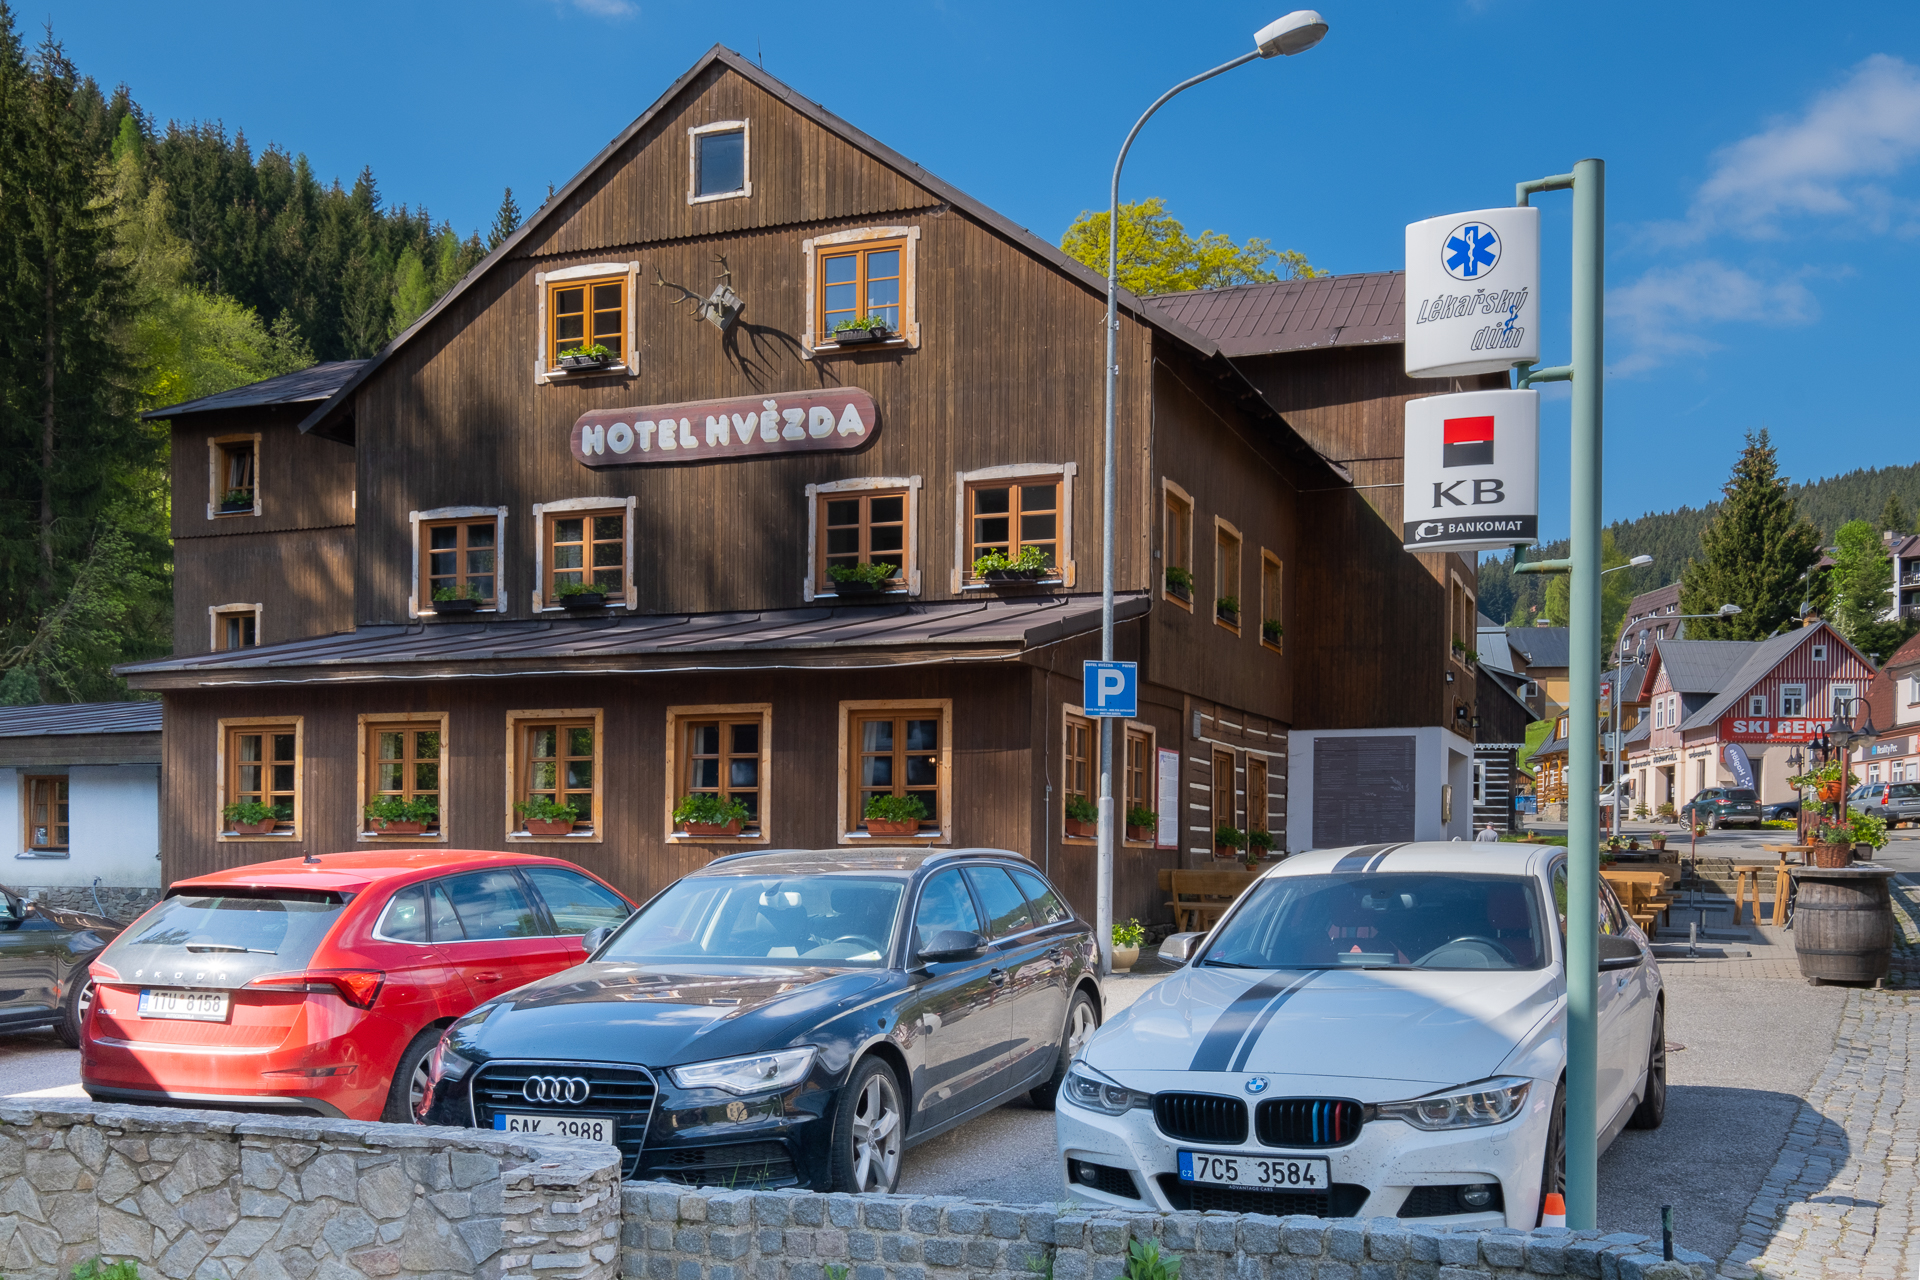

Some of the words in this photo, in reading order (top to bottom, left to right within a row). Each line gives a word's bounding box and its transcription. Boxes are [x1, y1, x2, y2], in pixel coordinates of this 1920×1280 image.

[1416, 286, 1528, 328] Lékařský
[1471, 321, 1525, 351] dům
[581, 417, 699, 456] HOTEL
[705, 400, 866, 447] HVĚZDA
[1432, 478, 1506, 508] KB
[1448, 520, 1523, 534] BANKOMAT
[1098, 669, 1125, 707] P
[1733, 720, 1769, 733] SKI
[1777, 721, 1833, 734] RENT
[1876, 744, 1890, 755] Reality
[1890, 743, 1898, 753] Pec
[153, 992, 177, 1010] 1TU
[186, 993, 221, 1013] 8158
[509, 1118, 542, 1133] 6AK
[556, 1121, 603, 1142] 3988
[1181, 1169, 1192, 1178] CZ
[1197, 1156, 1239, 1182] 7C5
[1257, 1161, 1317, 1186] 3584
[1228, 1184, 1260, 1192] ADVANTAGE
